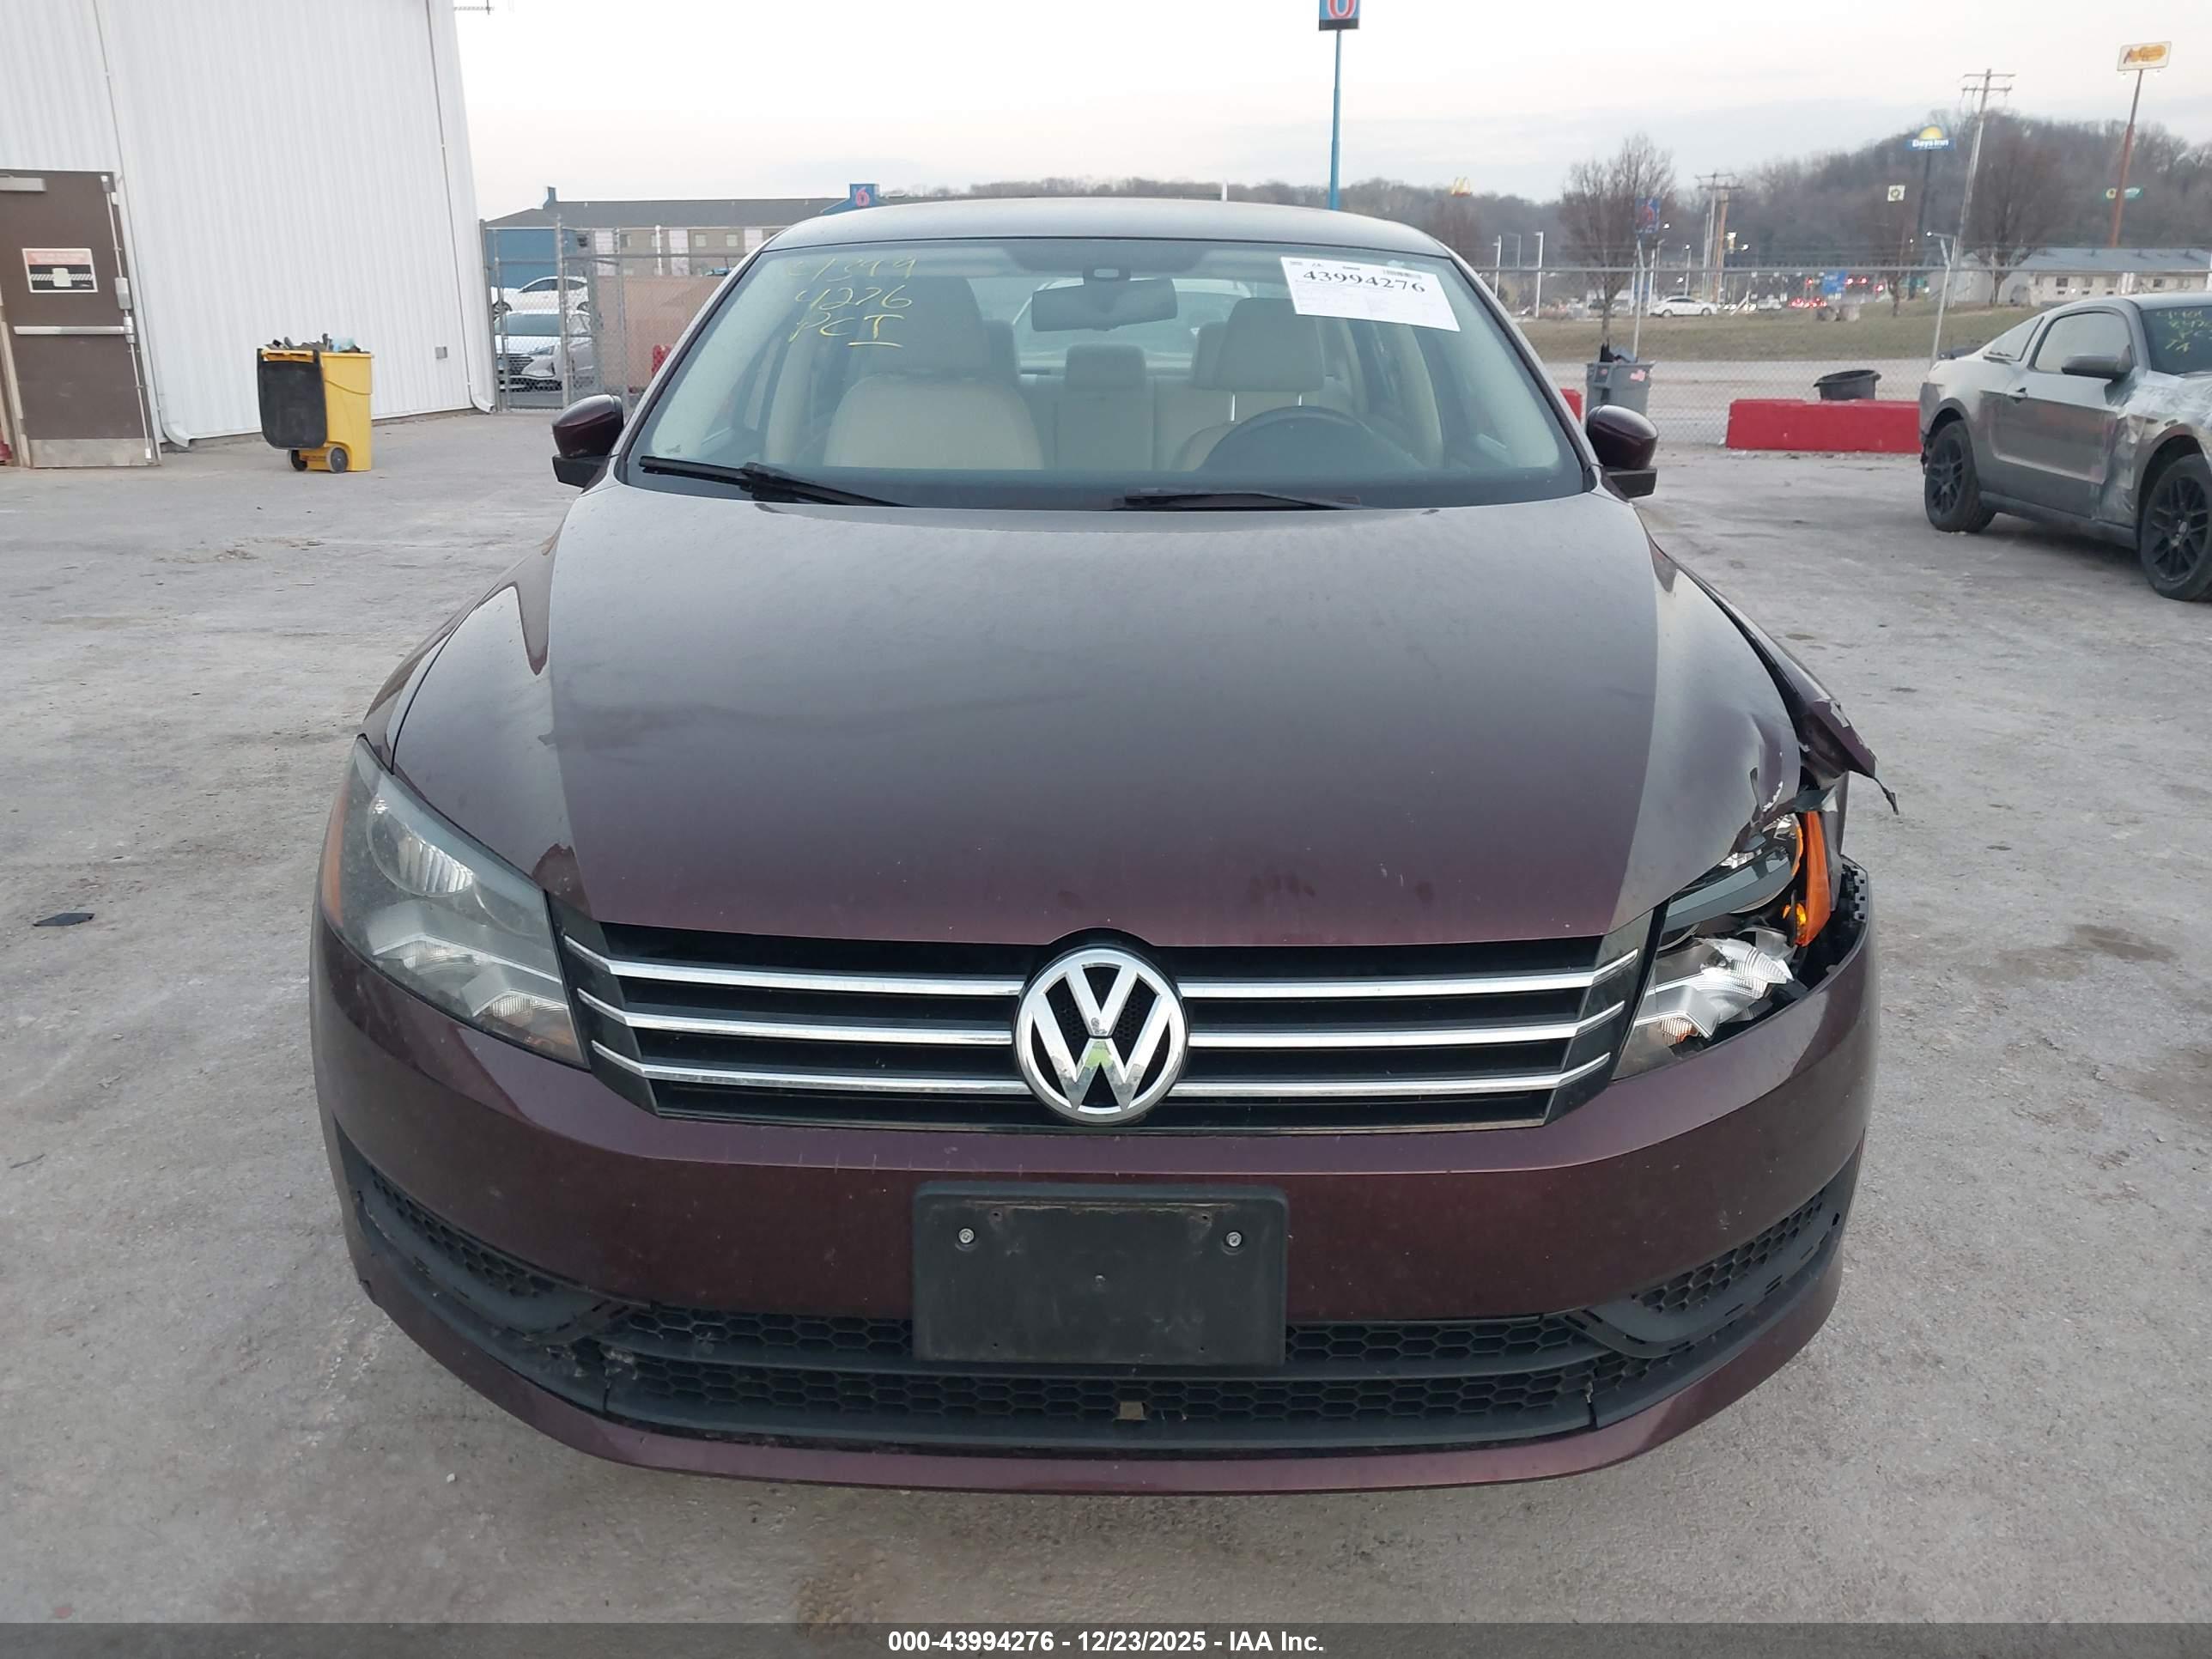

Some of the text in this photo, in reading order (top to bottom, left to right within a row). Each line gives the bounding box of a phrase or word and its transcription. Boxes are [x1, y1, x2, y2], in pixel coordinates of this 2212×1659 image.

[855, 186, 870, 207] 6
[1303, 270, 1426, 294] 43994276
[795, 285, 913, 311] 4276
